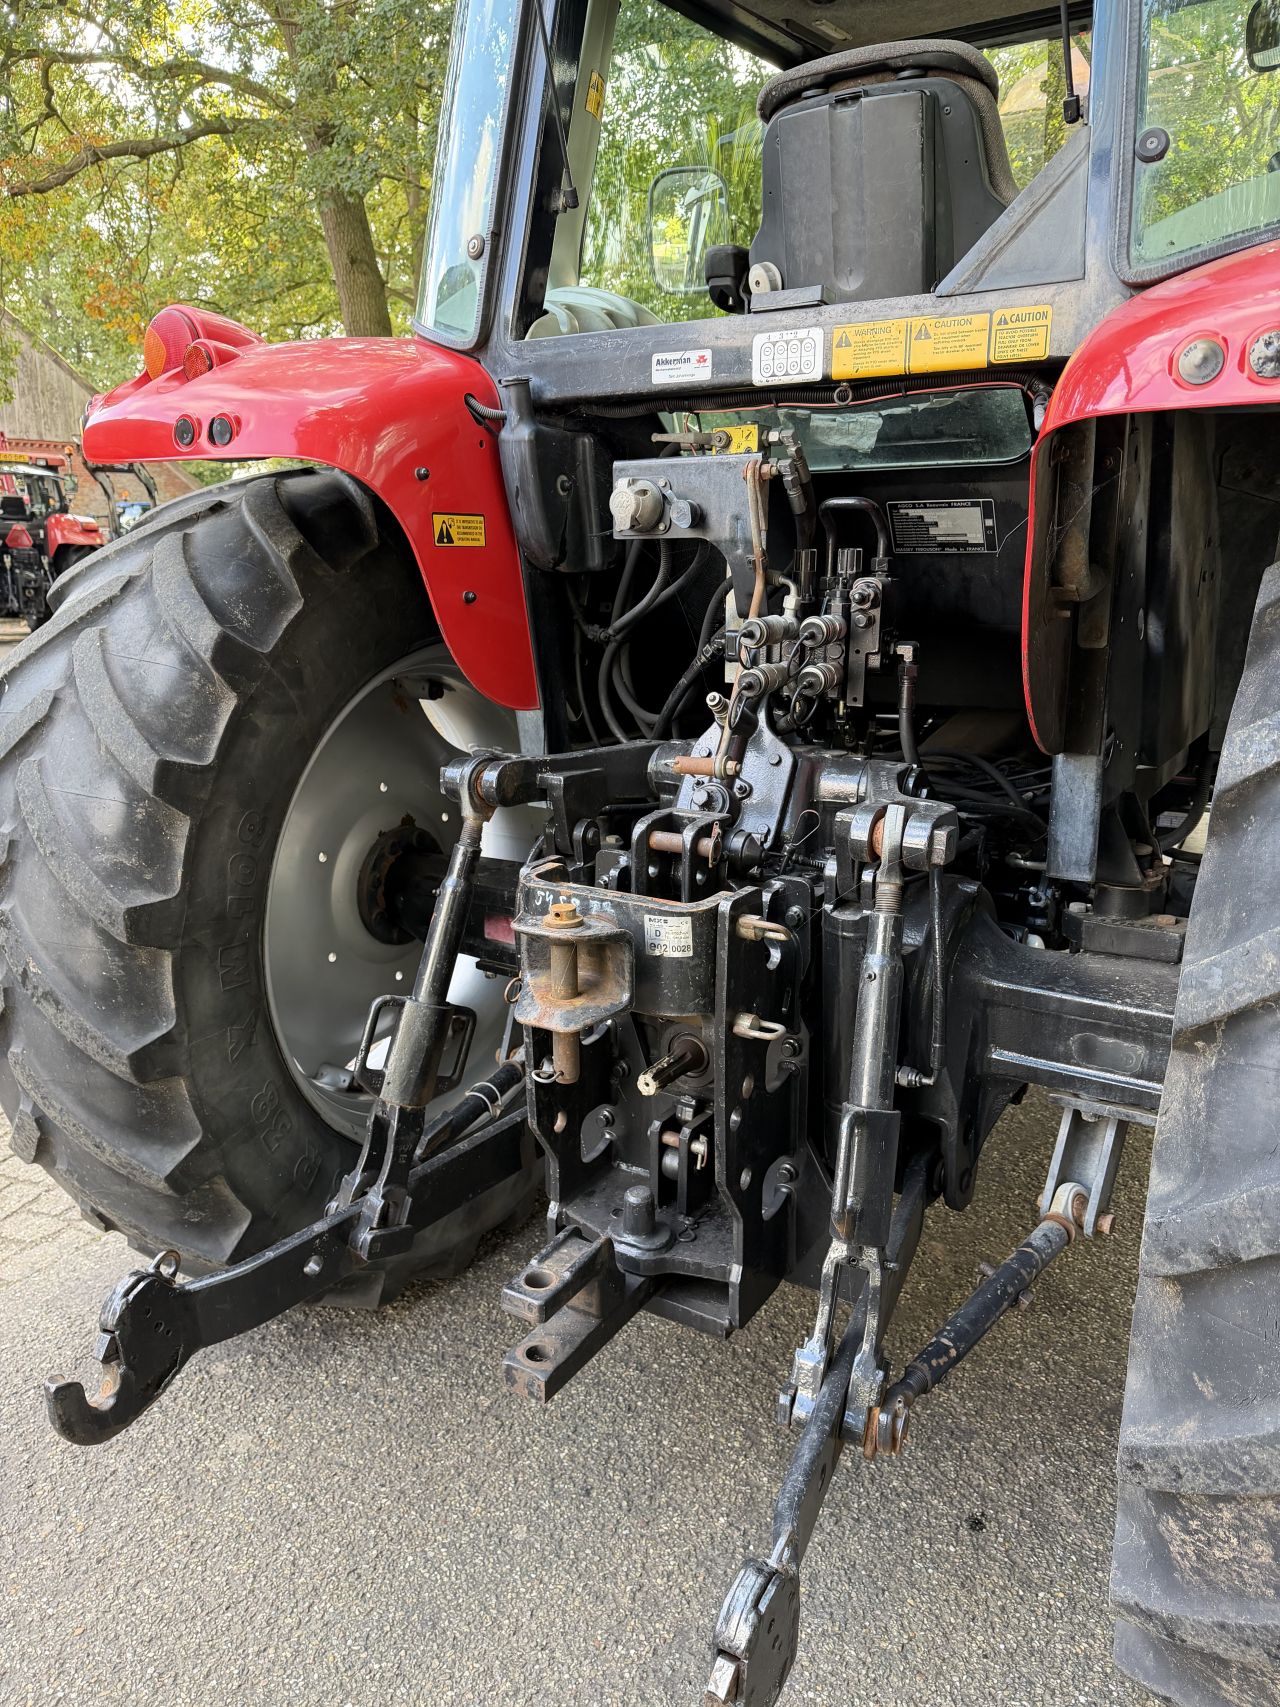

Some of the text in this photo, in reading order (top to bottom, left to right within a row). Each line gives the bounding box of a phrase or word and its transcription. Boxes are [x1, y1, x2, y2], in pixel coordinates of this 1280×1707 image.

[1010, 311, 1048, 323] CAUTION
[935, 318, 972, 328] CAUTION
[855, 326, 891, 336] WARNING
[656, 357, 690, 366] Akkerman
